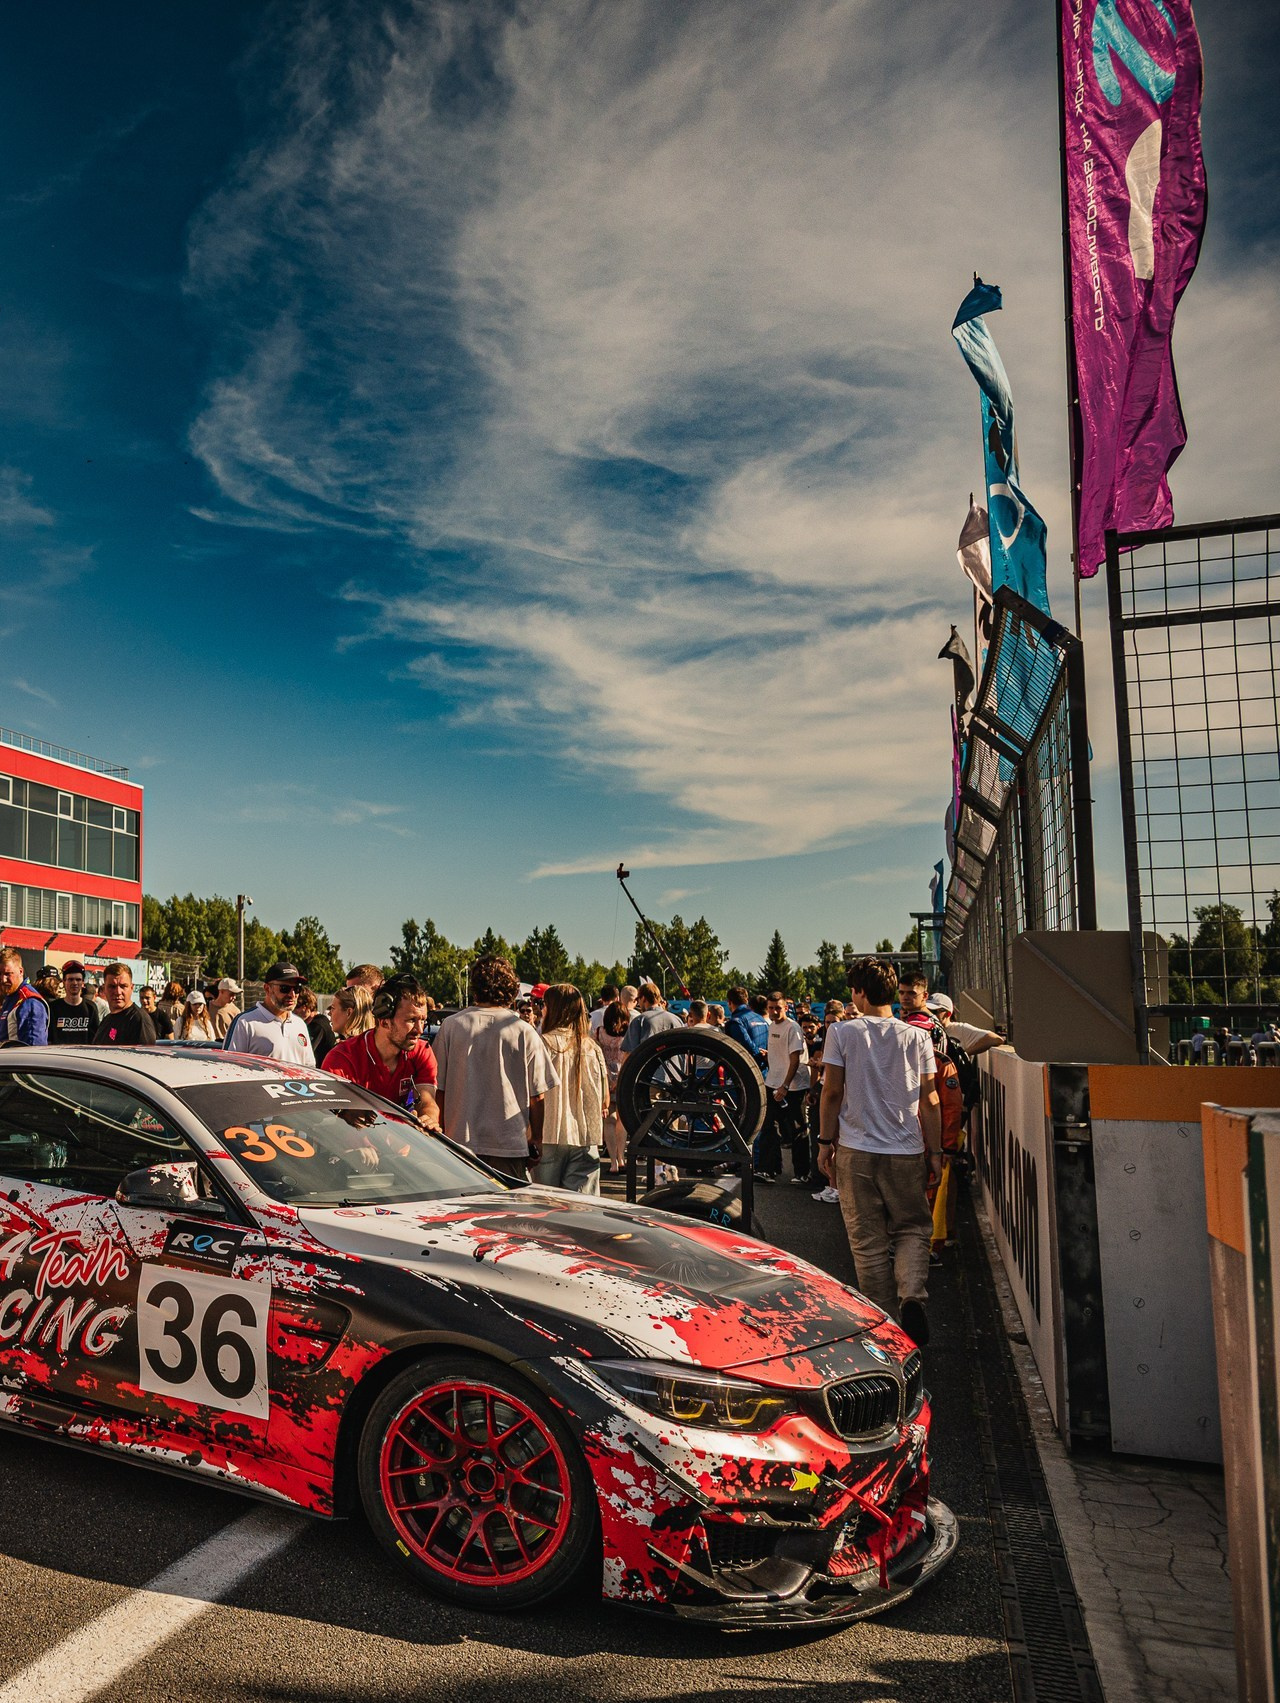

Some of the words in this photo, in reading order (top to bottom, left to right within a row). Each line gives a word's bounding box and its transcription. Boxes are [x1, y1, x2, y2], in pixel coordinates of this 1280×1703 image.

[224, 1124, 316, 1163] 36
[28, 1229, 130, 1300] Team
[144, 1280, 258, 1400] 36
